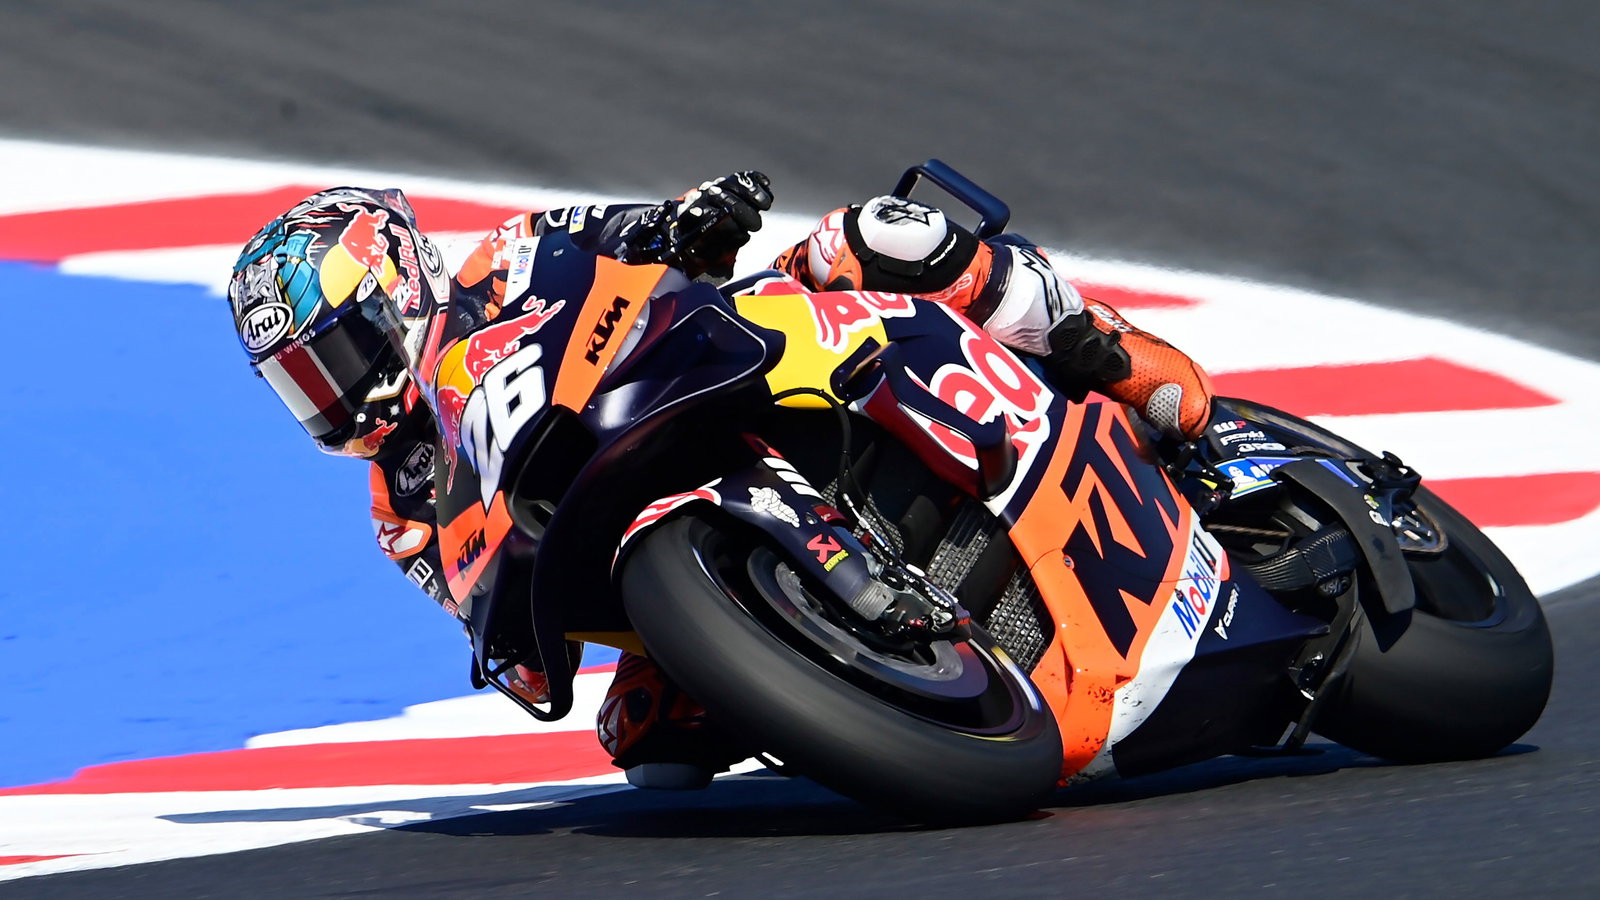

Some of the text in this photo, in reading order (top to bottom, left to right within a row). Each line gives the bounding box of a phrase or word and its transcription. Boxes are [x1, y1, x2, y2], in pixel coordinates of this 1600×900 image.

[246, 307, 282, 347] Arai
[585, 296, 631, 366] KTM
[460, 343, 546, 514] 26
[457, 529, 486, 581] KTM
[1060, 402, 1181, 660] KTM
[1172, 550, 1216, 640] Mobil
